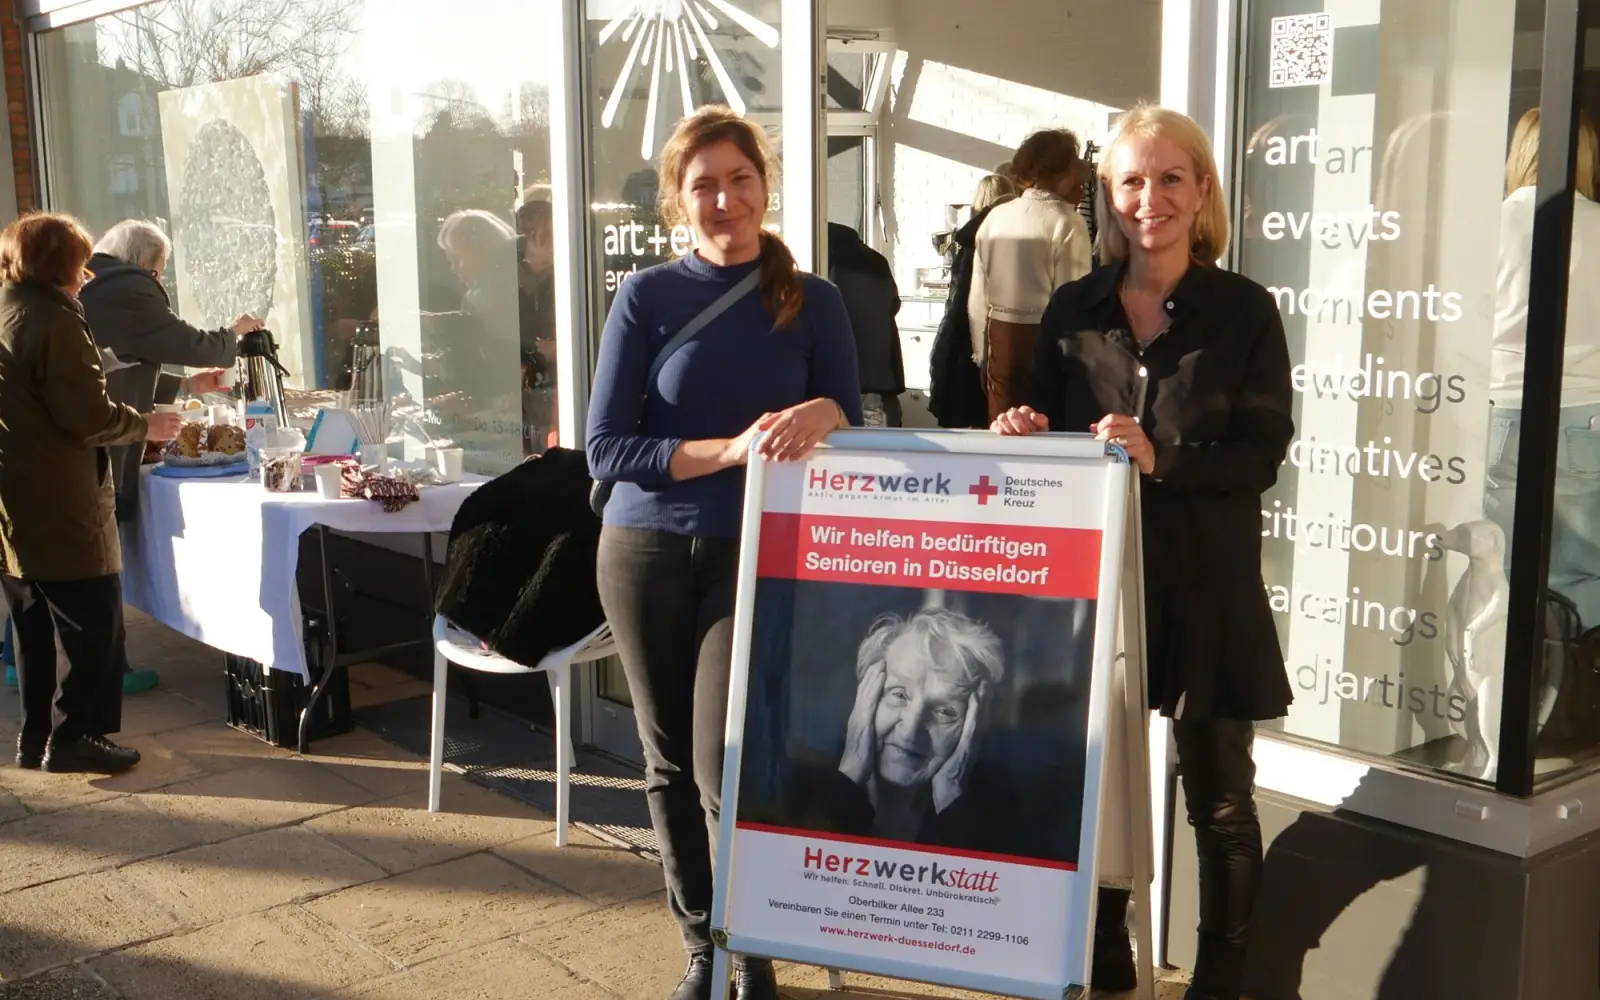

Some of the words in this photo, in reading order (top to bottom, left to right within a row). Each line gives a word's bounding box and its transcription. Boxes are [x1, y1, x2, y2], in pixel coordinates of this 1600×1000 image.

[1265, 127, 1321, 165] art
[809, 468, 951, 495] Herzwerk
[1004, 476, 1063, 488] Deutsches
[1004, 486, 1036, 498] Rotes
[1003, 497, 1036, 508] Kreuz
[810, 525, 845, 545] Wir
[850, 528, 914, 549] helfen
[920, 532, 1047, 559] bedürftigen
[805, 552, 897, 575] Senioren
[903, 558, 922, 577] in
[929, 559, 1049, 585] Düsseldorf
[803, 846, 1000, 893] Herzwerkstatt
[803, 871, 818, 881] Wir
[821, 875, 850, 886] helfen:
[852, 879, 887, 890] Schnell.
[889, 884, 923, 896] Diskret.
[848, 896, 898, 911] Oberbilker
[900, 903, 925, 915] Allee
[927, 907, 945, 918] 233
[768, 898, 821, 915] Vereinbaren
[824, 907, 839, 917] Sie
[841, 910, 867, 922] einen
[869, 914, 900, 926] Termin
[903, 920, 929, 931] unter
[931, 923, 948, 934] Tel:
[950, 926, 973, 937] 0211
[976, 930, 1029, 946] 2299-1106
[820, 925, 976, 955] www.herzwerk-duesseldorf.de
